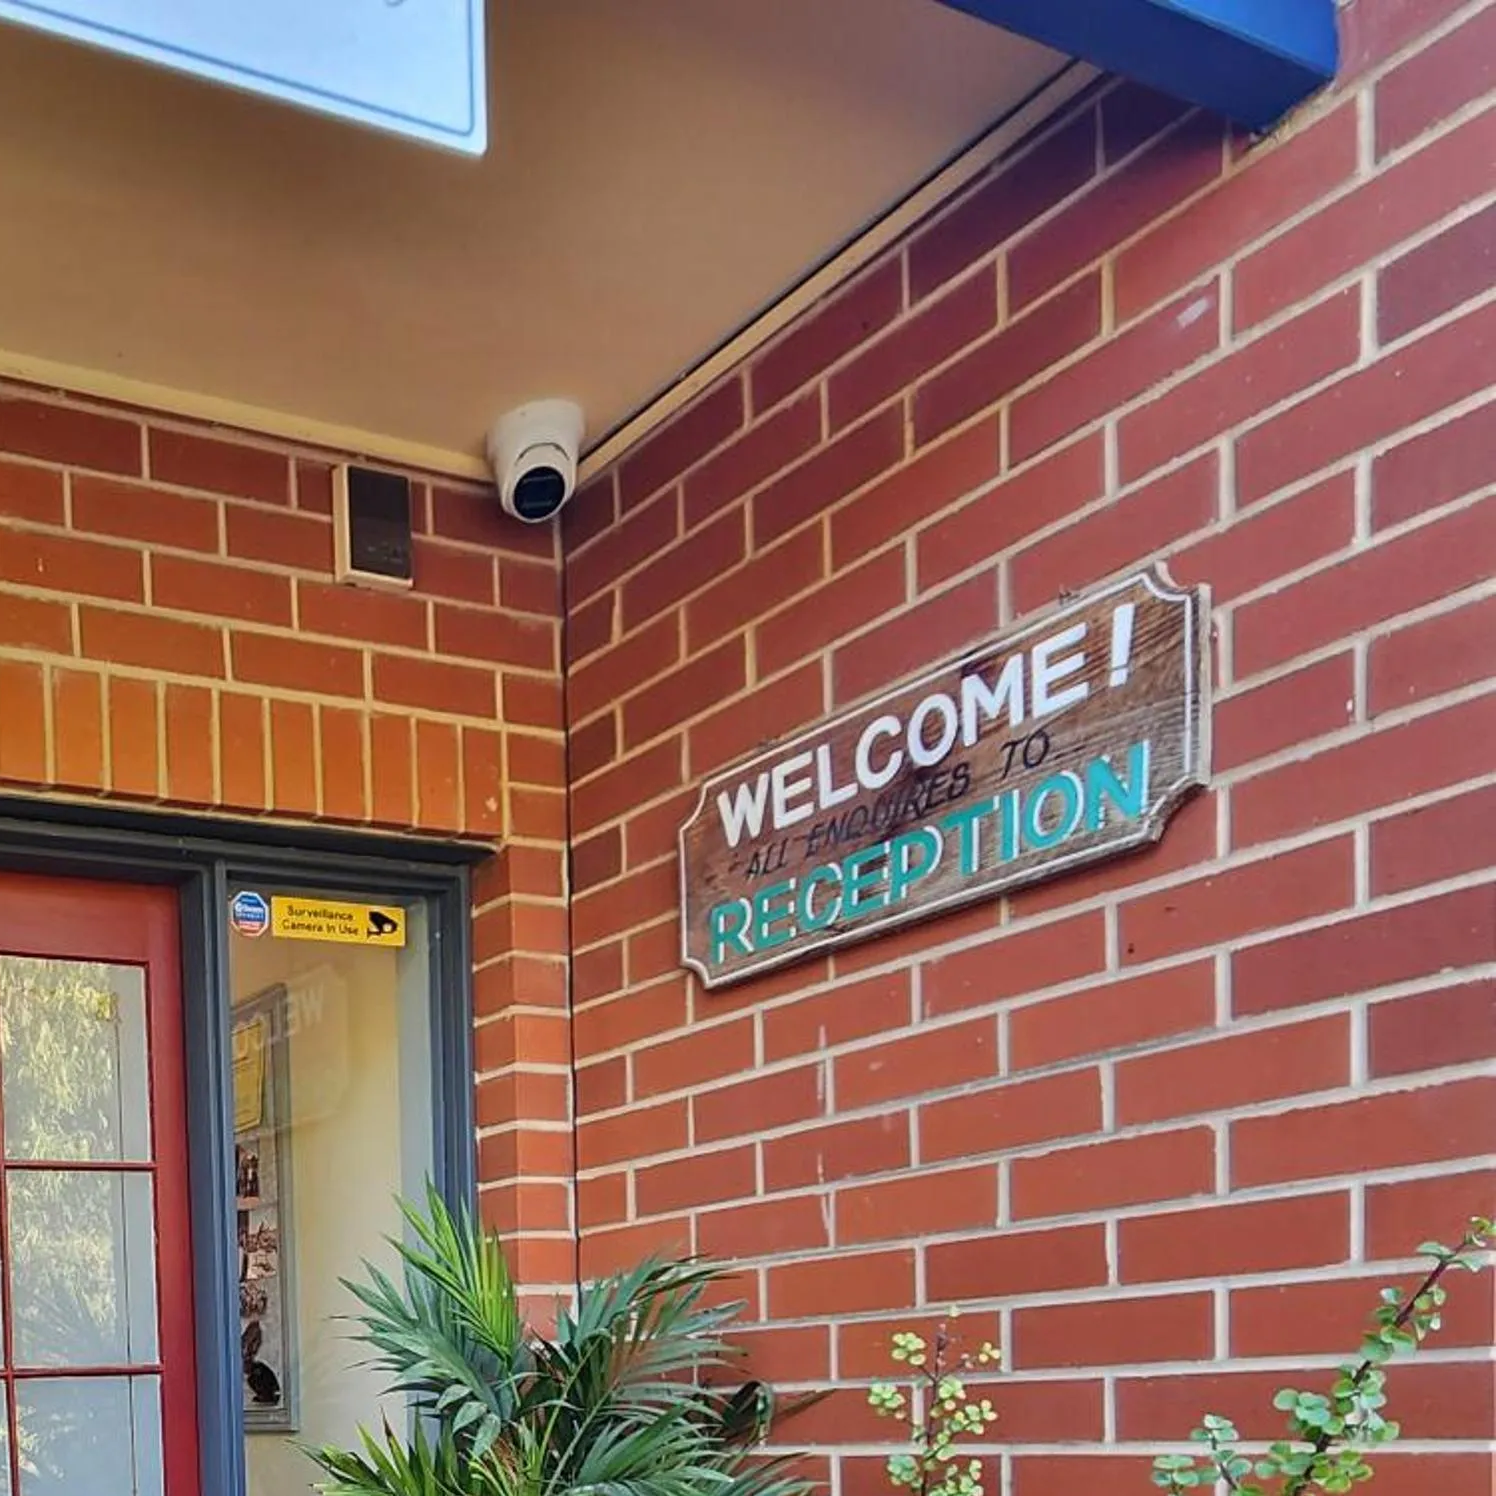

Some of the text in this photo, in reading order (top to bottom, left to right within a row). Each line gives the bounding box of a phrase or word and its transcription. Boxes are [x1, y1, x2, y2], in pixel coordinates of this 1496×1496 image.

[709, 739, 1151, 965] RECEPTION
[287, 905, 354, 921] Surveillance
[282, 919, 324, 932] Camera
[340, 925, 359, 936] Use
